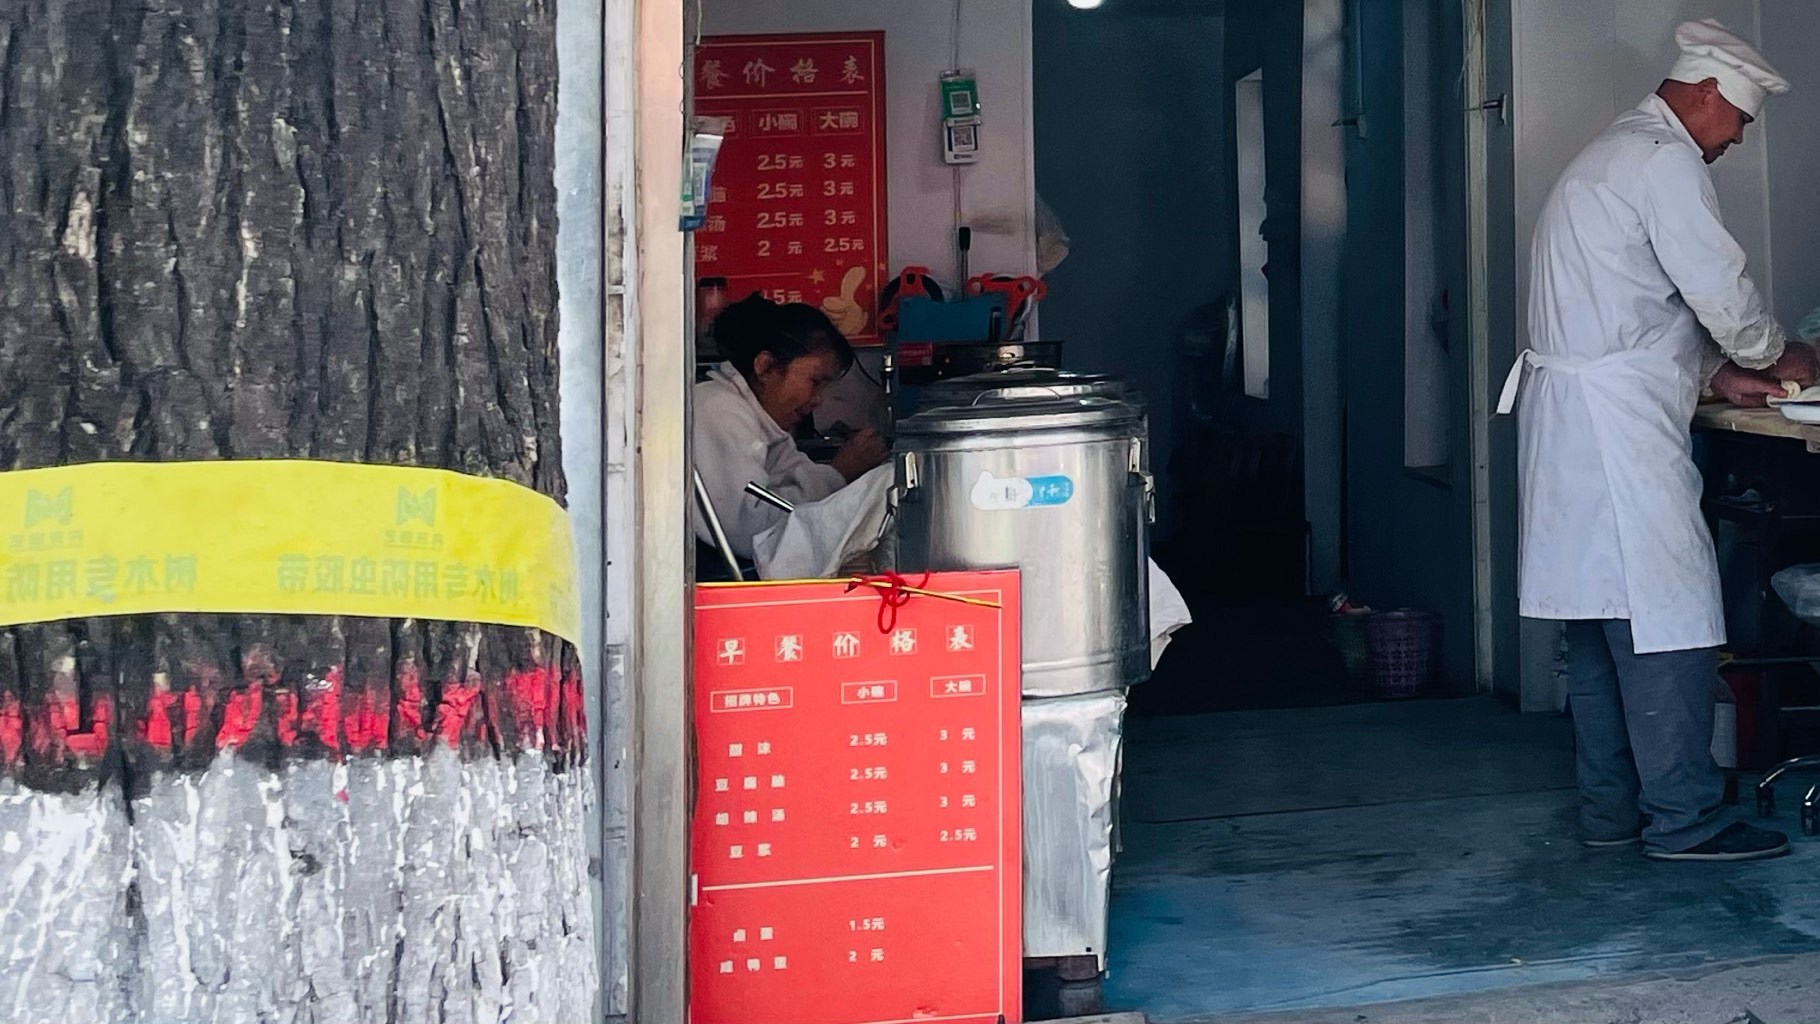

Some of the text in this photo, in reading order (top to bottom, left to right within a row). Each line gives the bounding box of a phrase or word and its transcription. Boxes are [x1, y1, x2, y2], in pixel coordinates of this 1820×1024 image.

[719, 627, 975, 664] 早餐价格表
[849, 732, 888, 746] 2.5元
[849, 767, 888, 780] 2.5元
[849, 800, 888, 814] 2.5元
[939, 828, 977, 842] 2.5元
